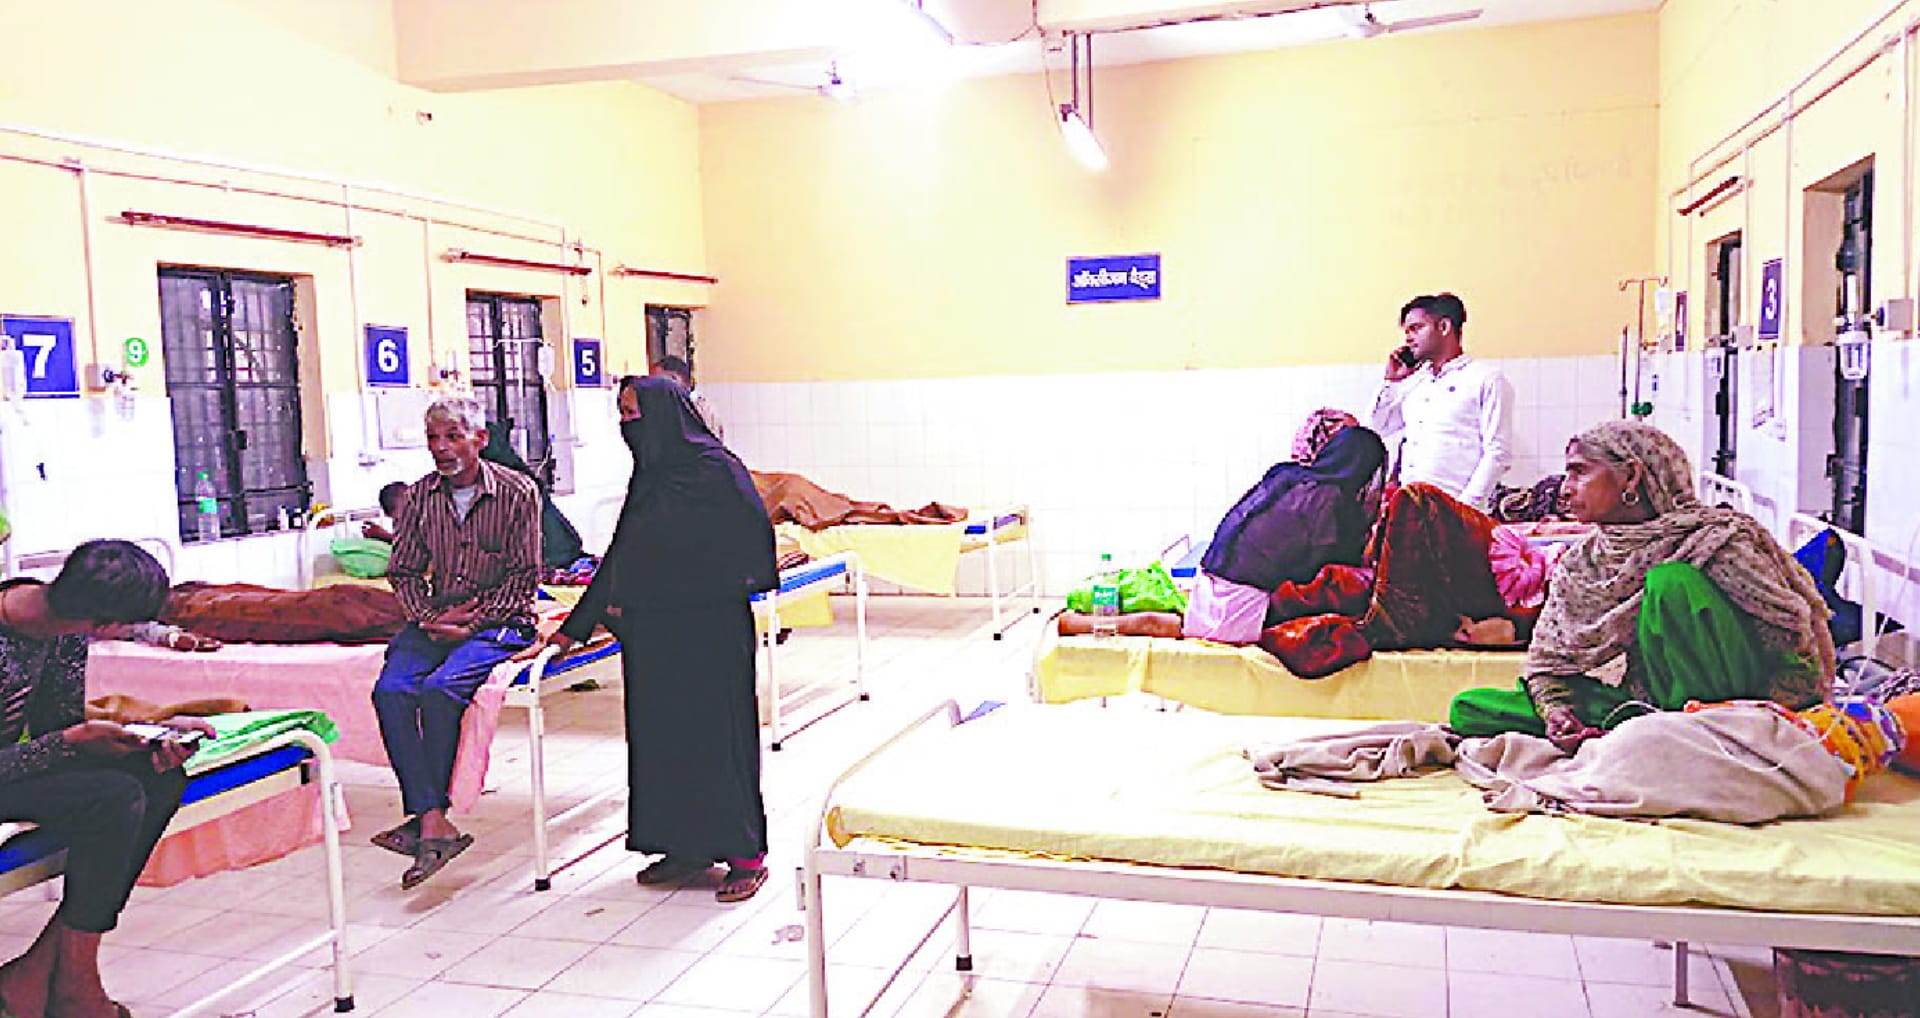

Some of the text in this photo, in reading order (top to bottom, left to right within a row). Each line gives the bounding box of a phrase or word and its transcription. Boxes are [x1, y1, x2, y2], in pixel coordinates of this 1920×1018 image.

[1764, 278, 1777, 320] 3
[22, 334, 57, 379] 7
[128, 341, 143, 363] 9
[378, 338, 399, 372] 6
[582, 349, 595, 377] 5
